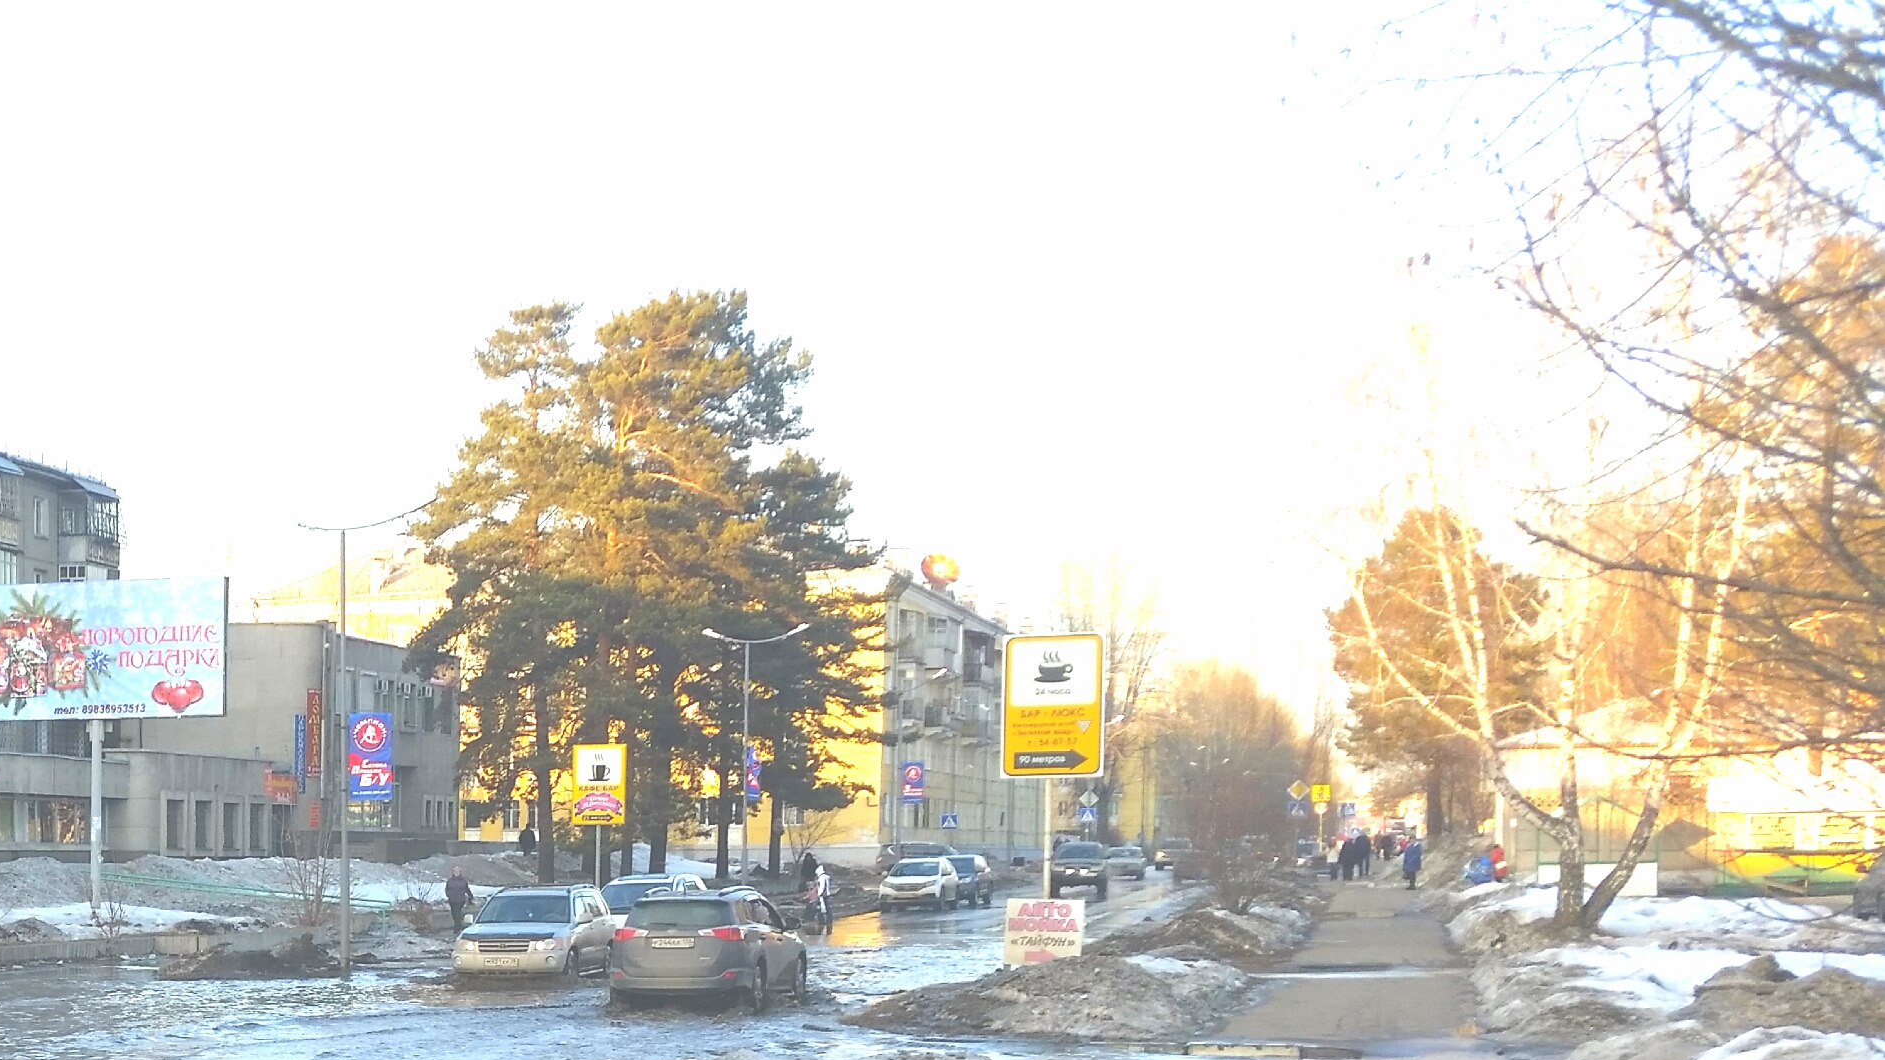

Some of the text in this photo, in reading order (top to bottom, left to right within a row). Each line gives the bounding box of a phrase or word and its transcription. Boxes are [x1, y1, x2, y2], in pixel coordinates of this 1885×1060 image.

[81, 624, 221, 646] НОВОГОДНИЕ
[118, 649, 220, 677] ПОДАРКИ
[1020, 710, 1041, 718] БАР
[1051, 708, 1085, 717] ЛЮКС
[1032, 756, 1066, 764] метров
[359, 773, 390, 787] Б/У
[1017, 903, 1072, 917] АВТО
[1008, 916, 1079, 932] МОЙКА
